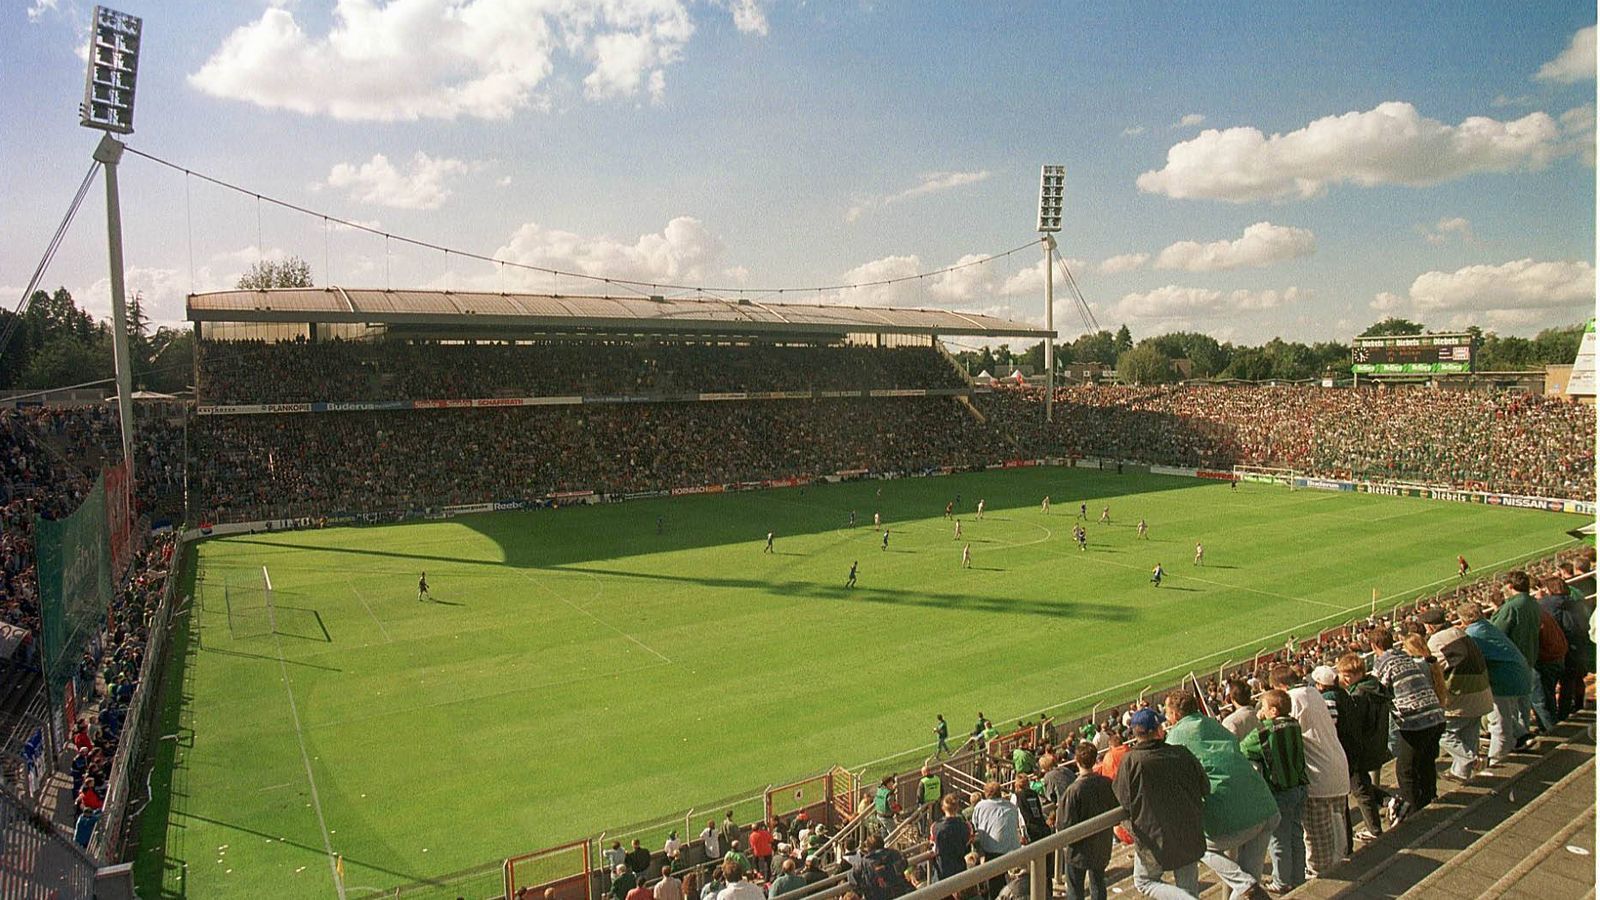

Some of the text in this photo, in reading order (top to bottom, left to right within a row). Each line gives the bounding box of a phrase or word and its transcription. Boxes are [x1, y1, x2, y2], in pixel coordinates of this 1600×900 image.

[268, 404, 312, 412] PLANKOPIE
[327, 402, 374, 411] Buderus
[1503, 497, 1547, 509] NISSAN
